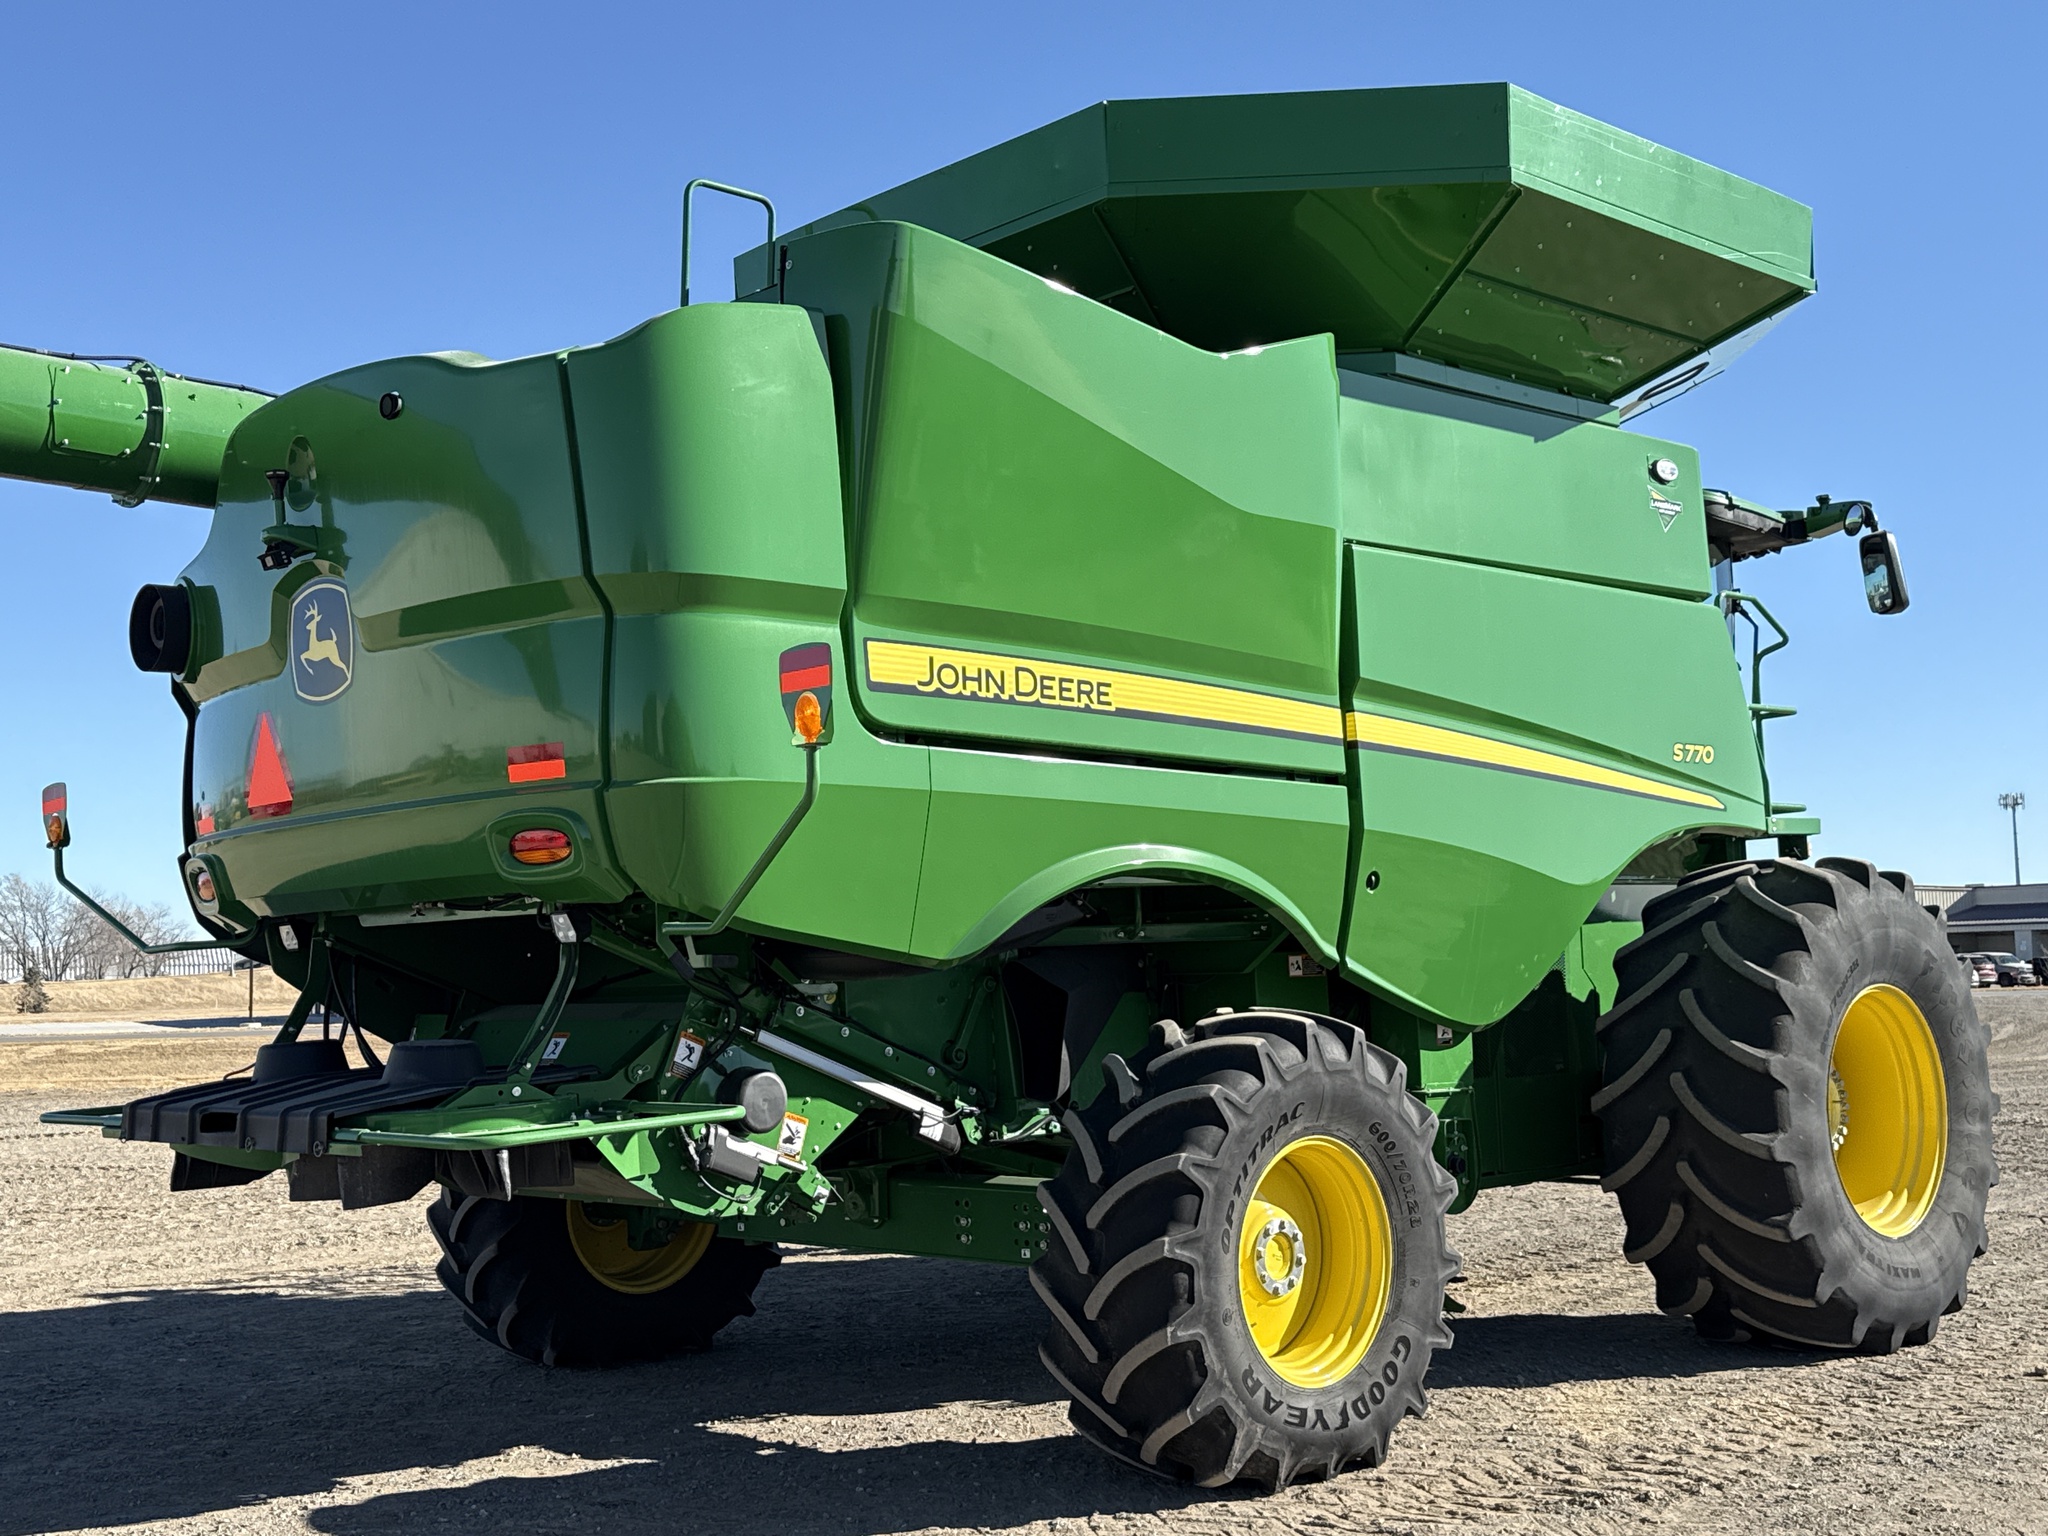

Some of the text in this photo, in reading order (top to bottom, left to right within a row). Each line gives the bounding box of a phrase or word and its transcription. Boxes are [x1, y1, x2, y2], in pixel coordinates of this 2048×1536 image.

[917, 656, 1113, 707] JOHN DEERE
[1673, 743, 1715, 765] S770
[1221, 1102, 1305, 1255] OPTITRAC
[1241, 1334, 1412, 1432] GOODYEAR
